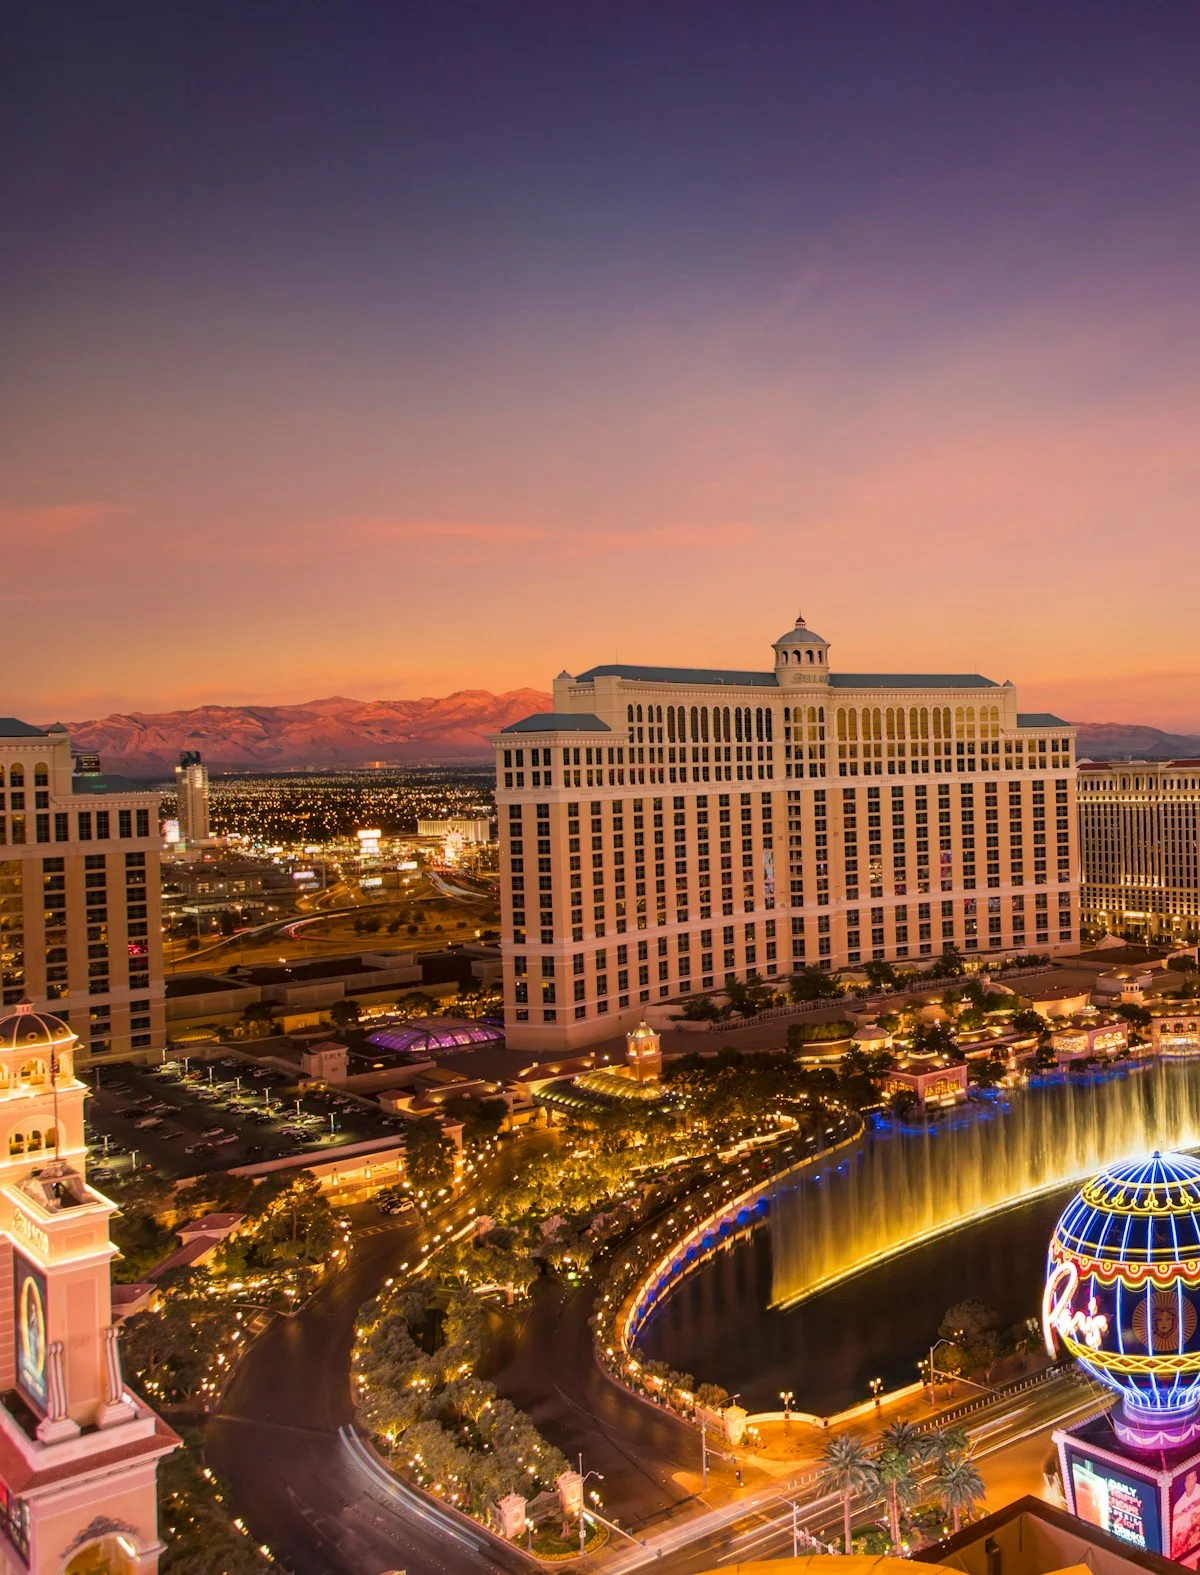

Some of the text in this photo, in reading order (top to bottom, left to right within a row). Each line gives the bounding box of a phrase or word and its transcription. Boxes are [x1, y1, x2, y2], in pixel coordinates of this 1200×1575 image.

[1108, 1478, 1138, 1498] DAILY
[1109, 1496, 1140, 1516] HOUR
[1110, 1489, 1143, 1508] HAPPY
[1113, 1523, 1147, 1548] DRINKS
